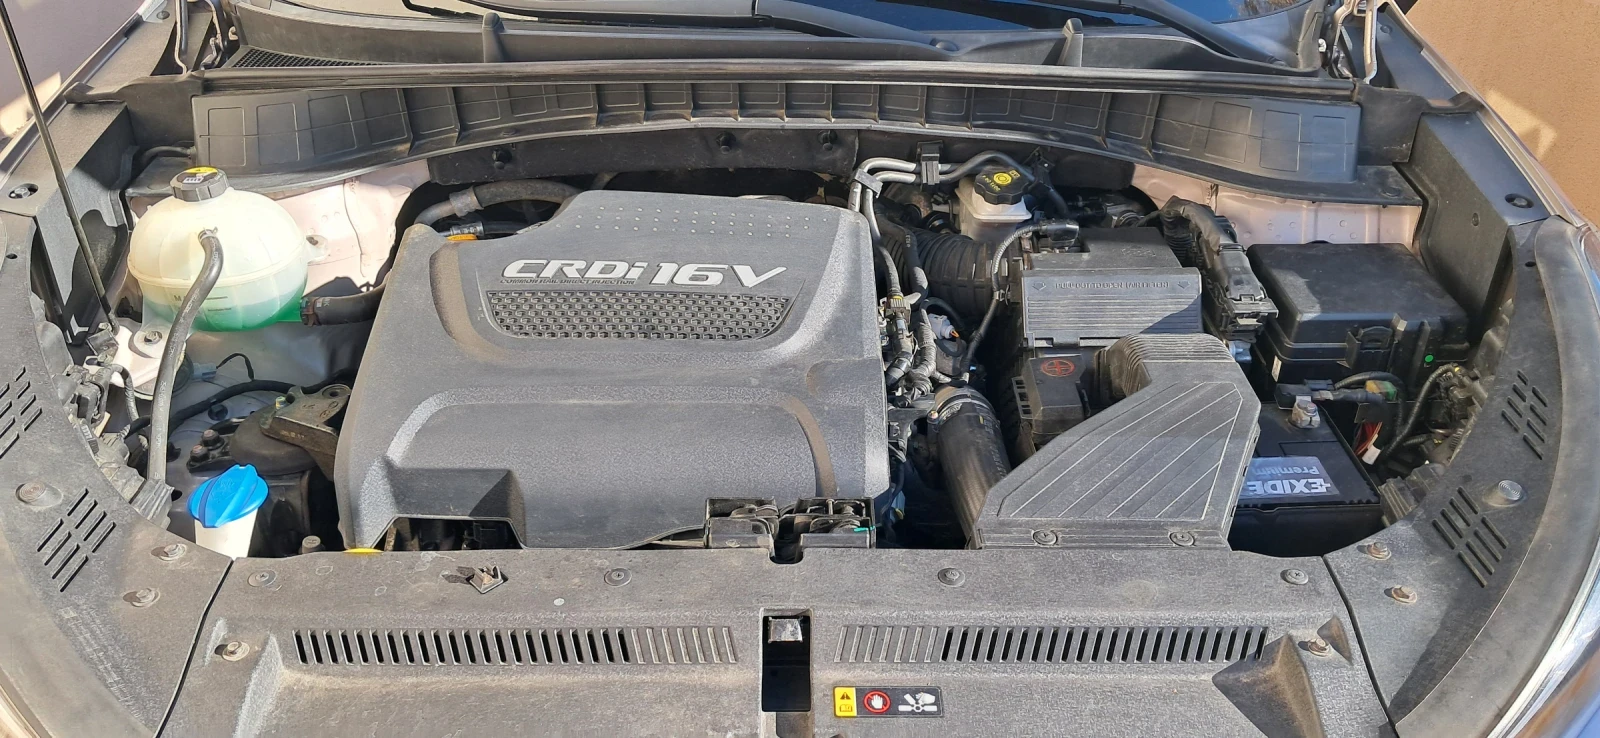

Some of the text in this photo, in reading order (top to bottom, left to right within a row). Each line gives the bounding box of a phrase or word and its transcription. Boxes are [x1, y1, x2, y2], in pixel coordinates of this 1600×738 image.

[501, 258, 787, 288] CRDi 16V
[1253, 466, 1320, 476] Premium
[1247, 478, 1330, 495] EXIDE
